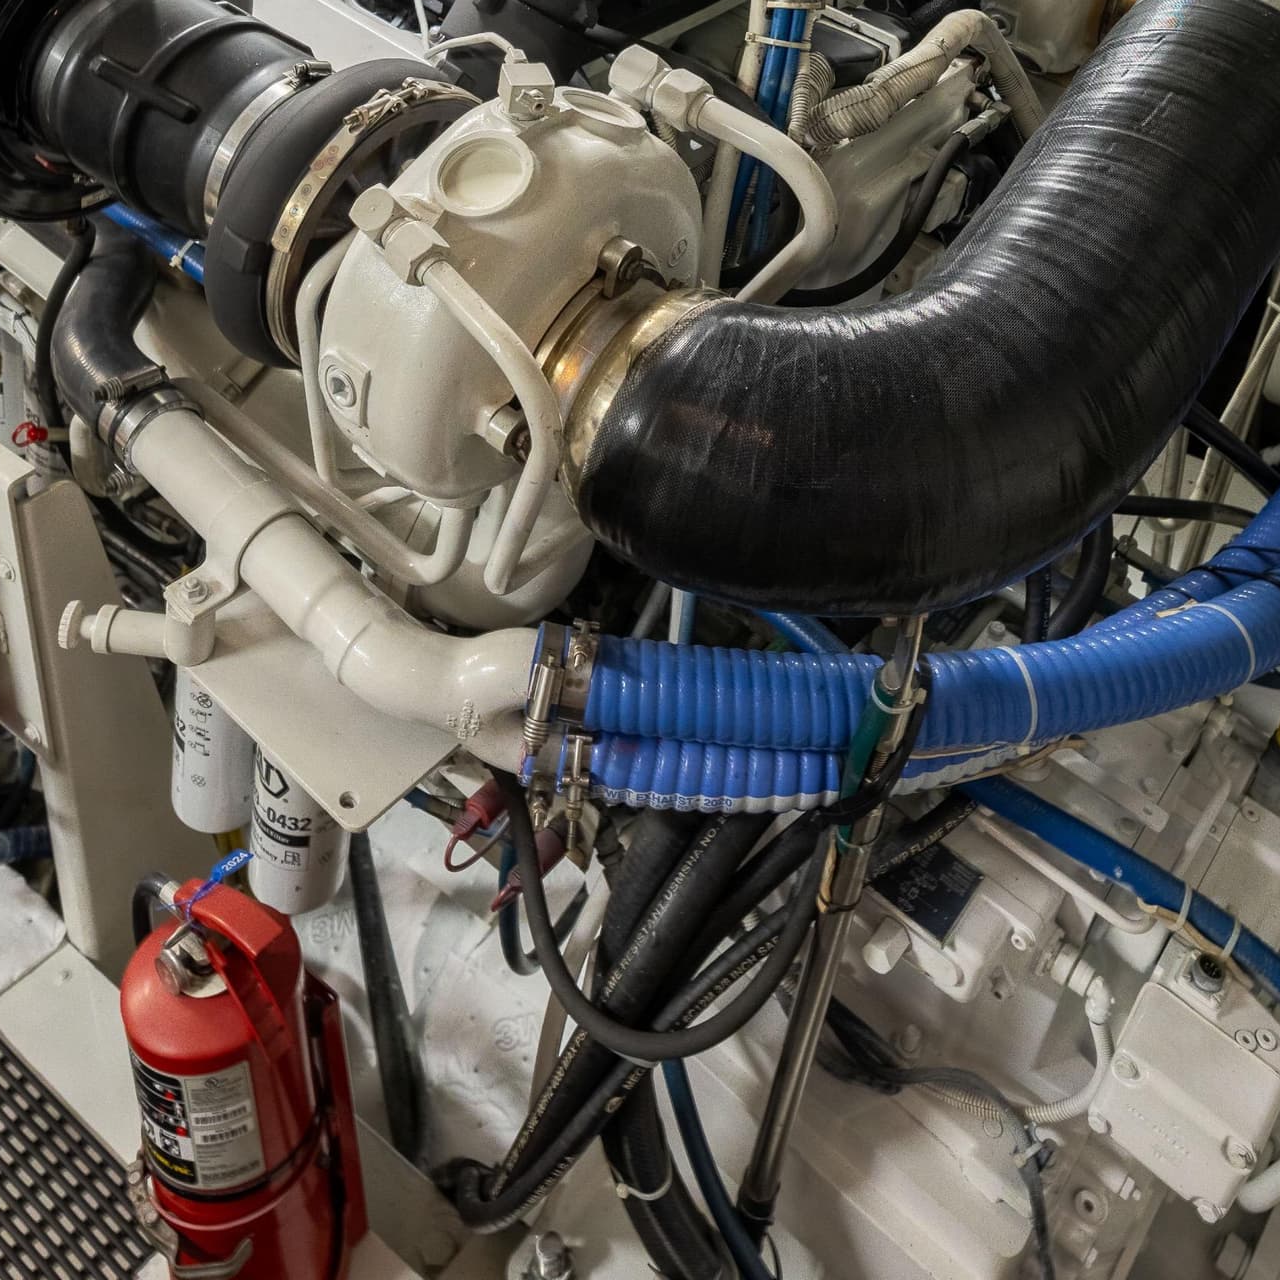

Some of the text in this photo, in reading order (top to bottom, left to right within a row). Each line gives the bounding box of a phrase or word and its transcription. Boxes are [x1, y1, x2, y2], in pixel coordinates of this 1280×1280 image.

[605, 788, 633, 802] WET
[635, 792, 695, 809] EXHAUST
[220, 851, 249, 871] 2024
